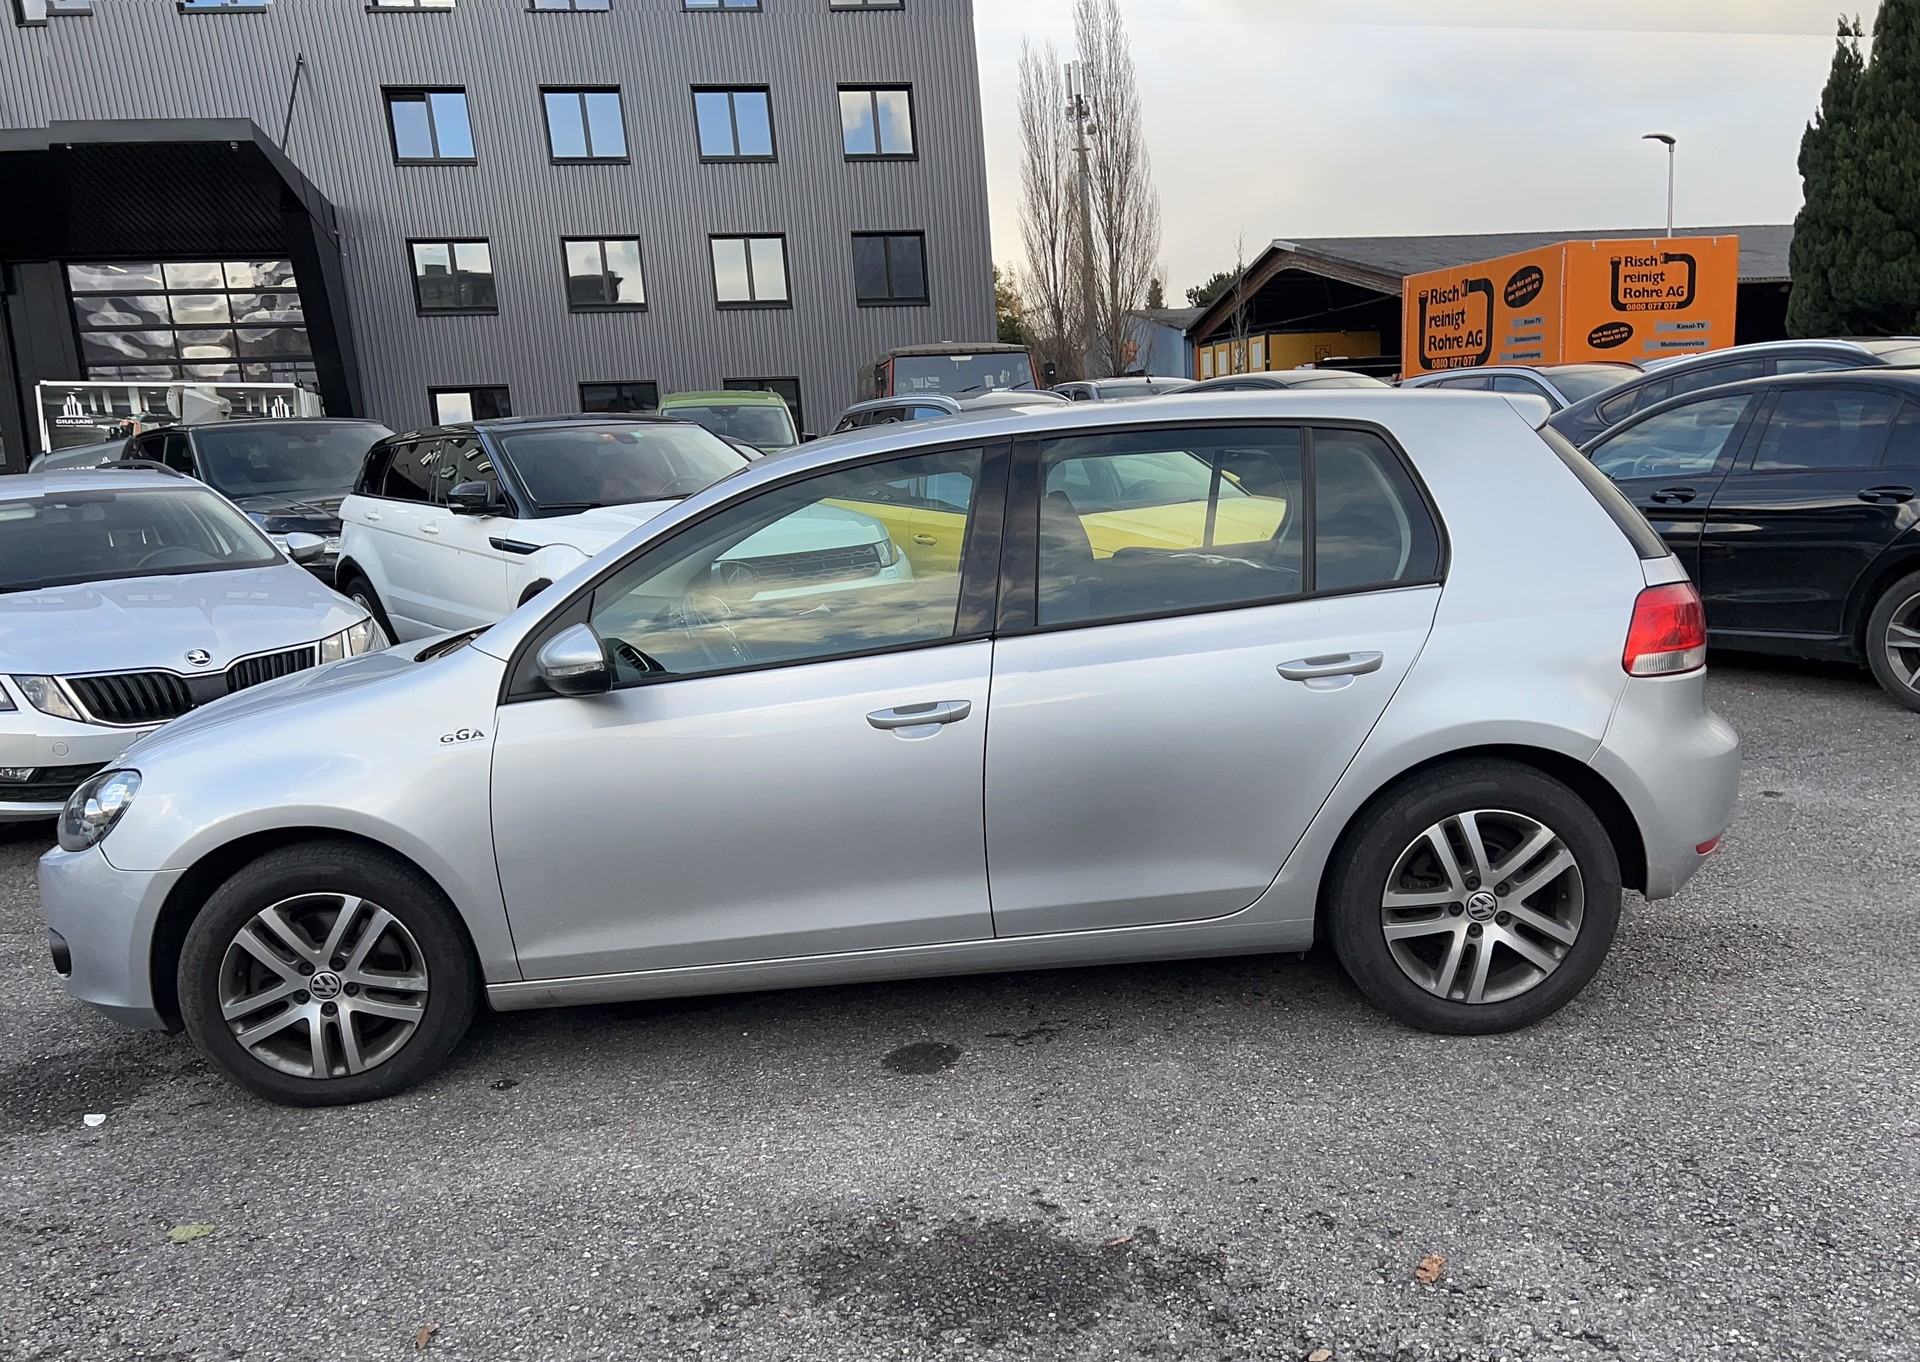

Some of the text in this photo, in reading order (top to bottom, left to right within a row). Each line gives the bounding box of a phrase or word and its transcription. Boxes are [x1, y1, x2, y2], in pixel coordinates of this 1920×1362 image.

[1624, 255, 1658, 267] Risch
[1623, 271, 1665, 286] reinigt
[1430, 285, 1460, 305] Risch
[1623, 285, 1684, 299] Rohre AG
[1626, 303, 1646, 311] 0800
[1429, 307, 1466, 330] reinigt
[1428, 329, 1483, 352] Rohre AG
[1463, 355, 1477, 366] 077
[440, 728, 485, 743] GGA
